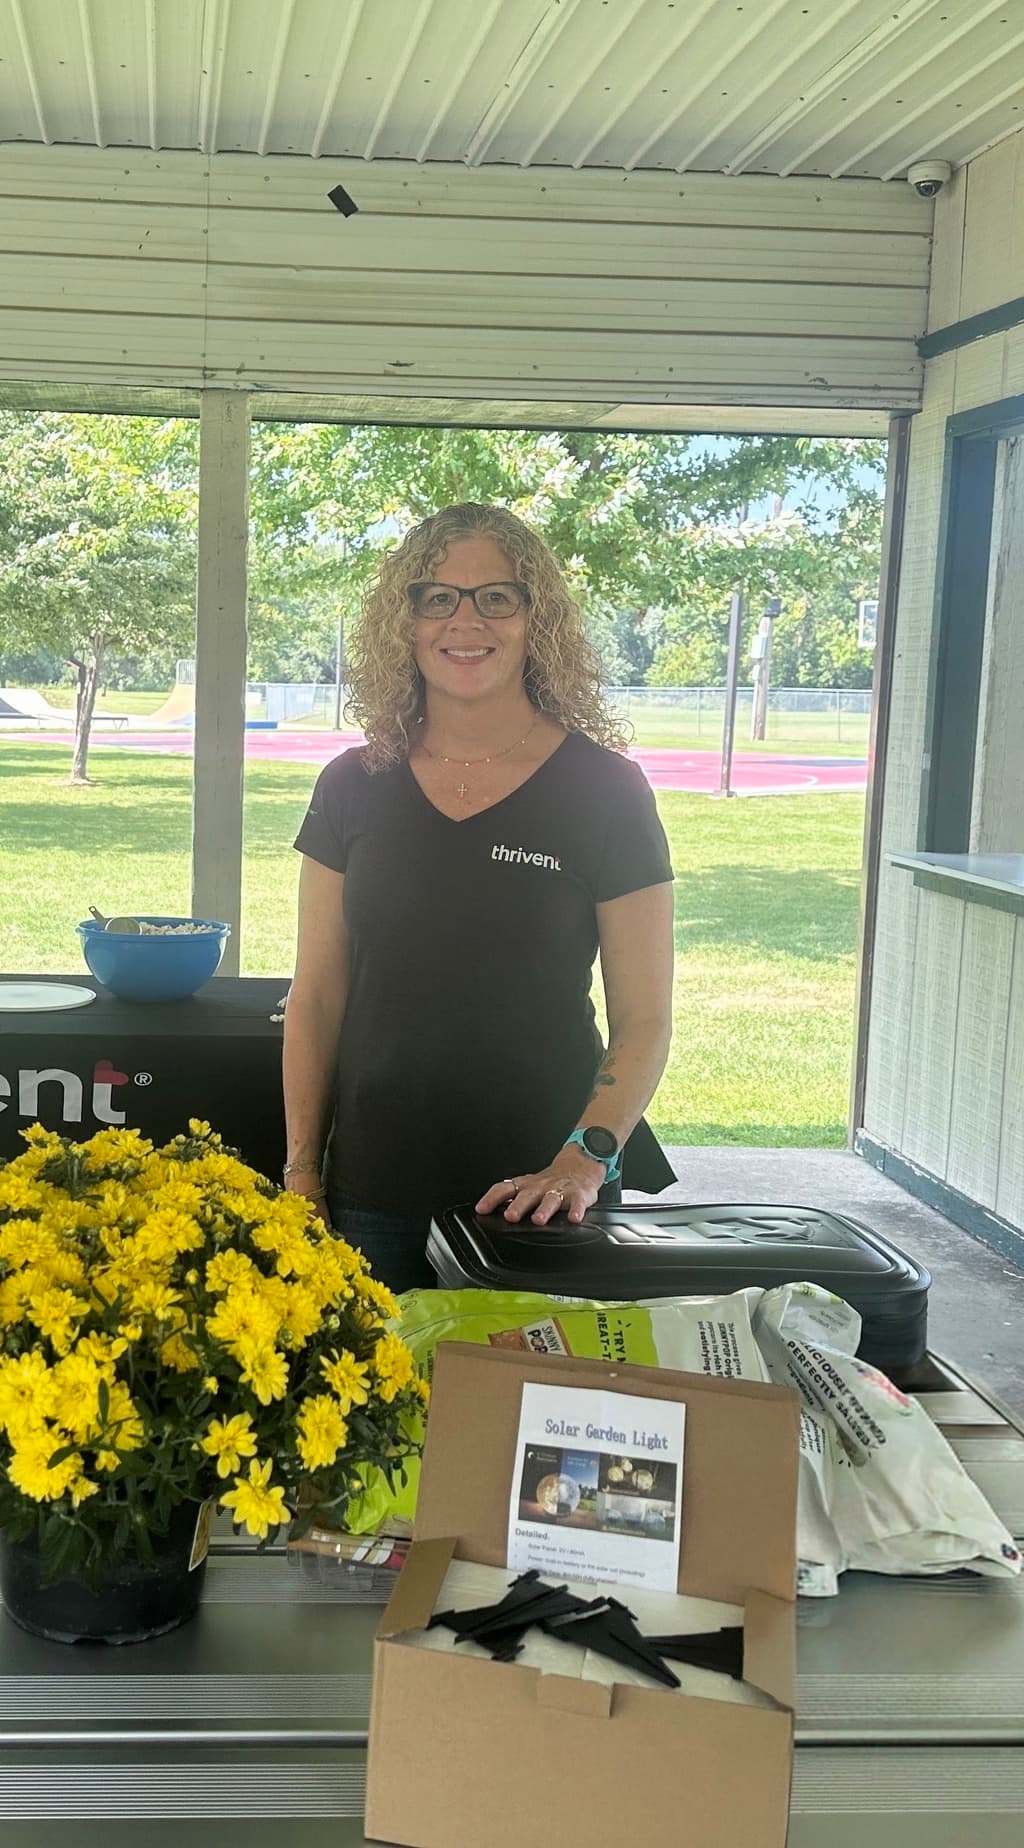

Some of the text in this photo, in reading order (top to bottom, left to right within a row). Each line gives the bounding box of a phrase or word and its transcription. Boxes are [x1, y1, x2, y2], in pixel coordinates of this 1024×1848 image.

[491, 844, 562, 871] thrivent
[613, 1330, 626, 1354] TRY
[700, 1331, 711, 1371] satisfying
[787, 1340, 837, 1400] PERFECTLY
[799, 1341, 852, 1396] LICIOUSLY
[545, 1418, 668, 1450] Solar Garden Light
